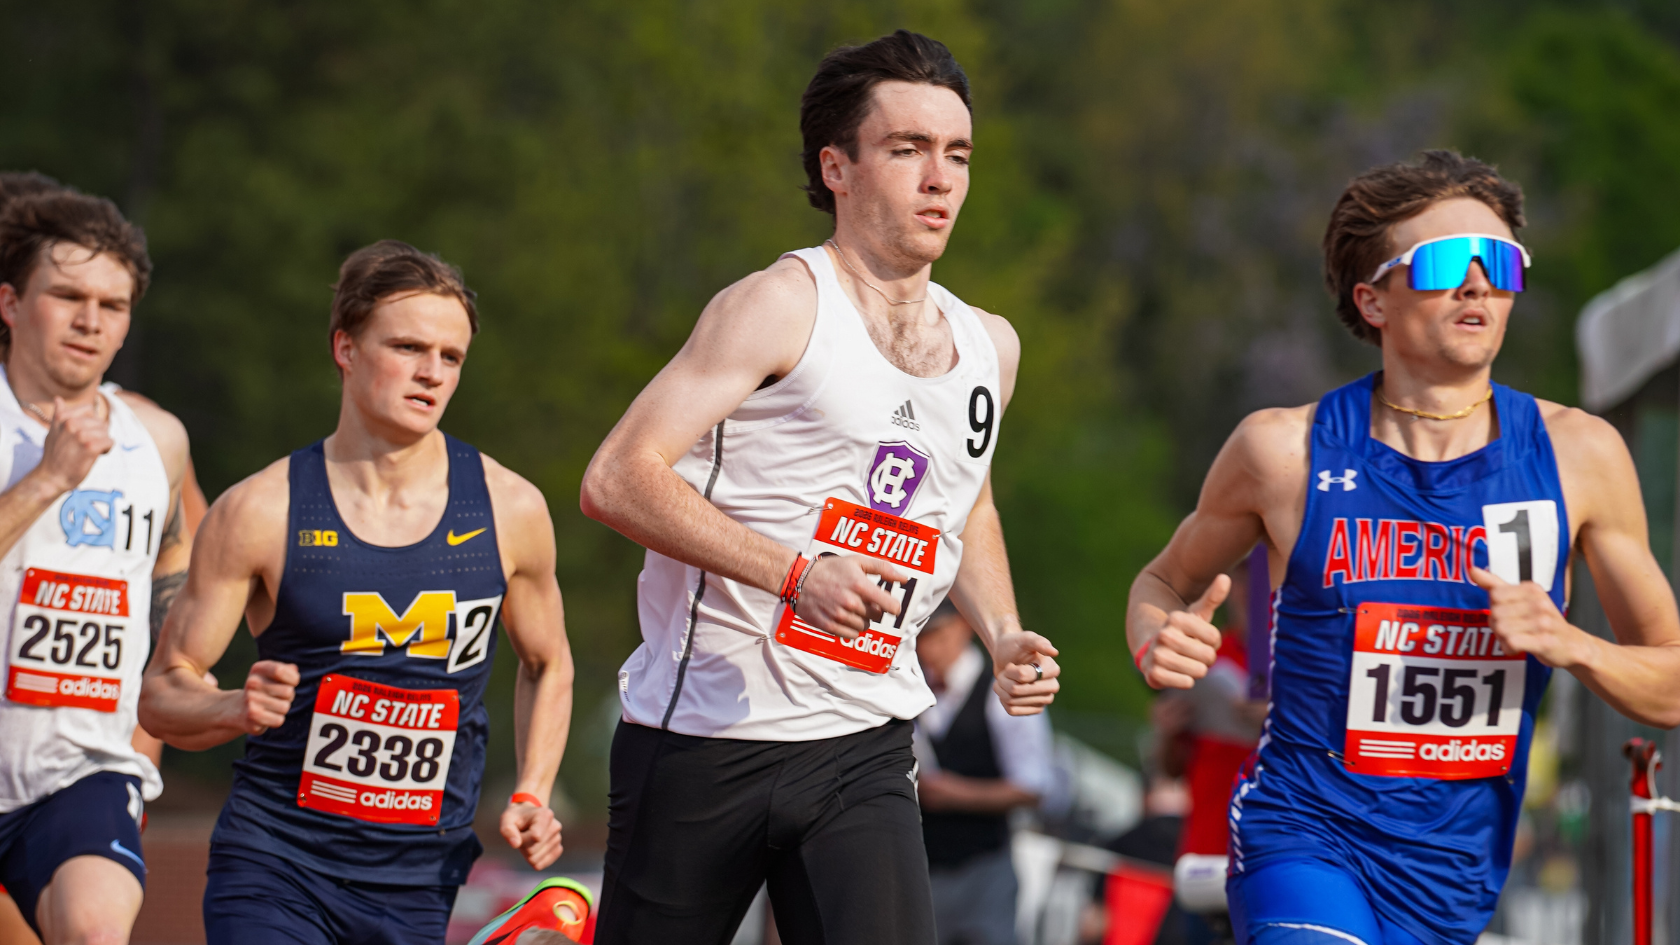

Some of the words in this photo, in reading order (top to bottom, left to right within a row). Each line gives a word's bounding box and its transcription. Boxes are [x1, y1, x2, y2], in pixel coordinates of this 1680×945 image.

[967, 386, 994, 458] 9
[122, 504, 154, 555] 11
[830, 516, 869, 548] NC
[866, 527, 929, 567] STATE
[1498, 509, 1533, 584] 1
[34, 581, 69, 608] NC
[68, 585, 121, 615] STATE
[18, 615, 124, 670] 2525
[340, 590, 457, 660] M
[454, 605, 493, 666] 2
[1374, 620, 1420, 652] NC
[59, 678, 119, 700] adidas
[331, 689, 370, 719] NC
[370, 698, 445, 729] STATE
[1366, 663, 1506, 728] 1551
[313, 722, 444, 783] 2338
[1419, 739, 1505, 761] adidas
[359, 791, 433, 811] adidas
